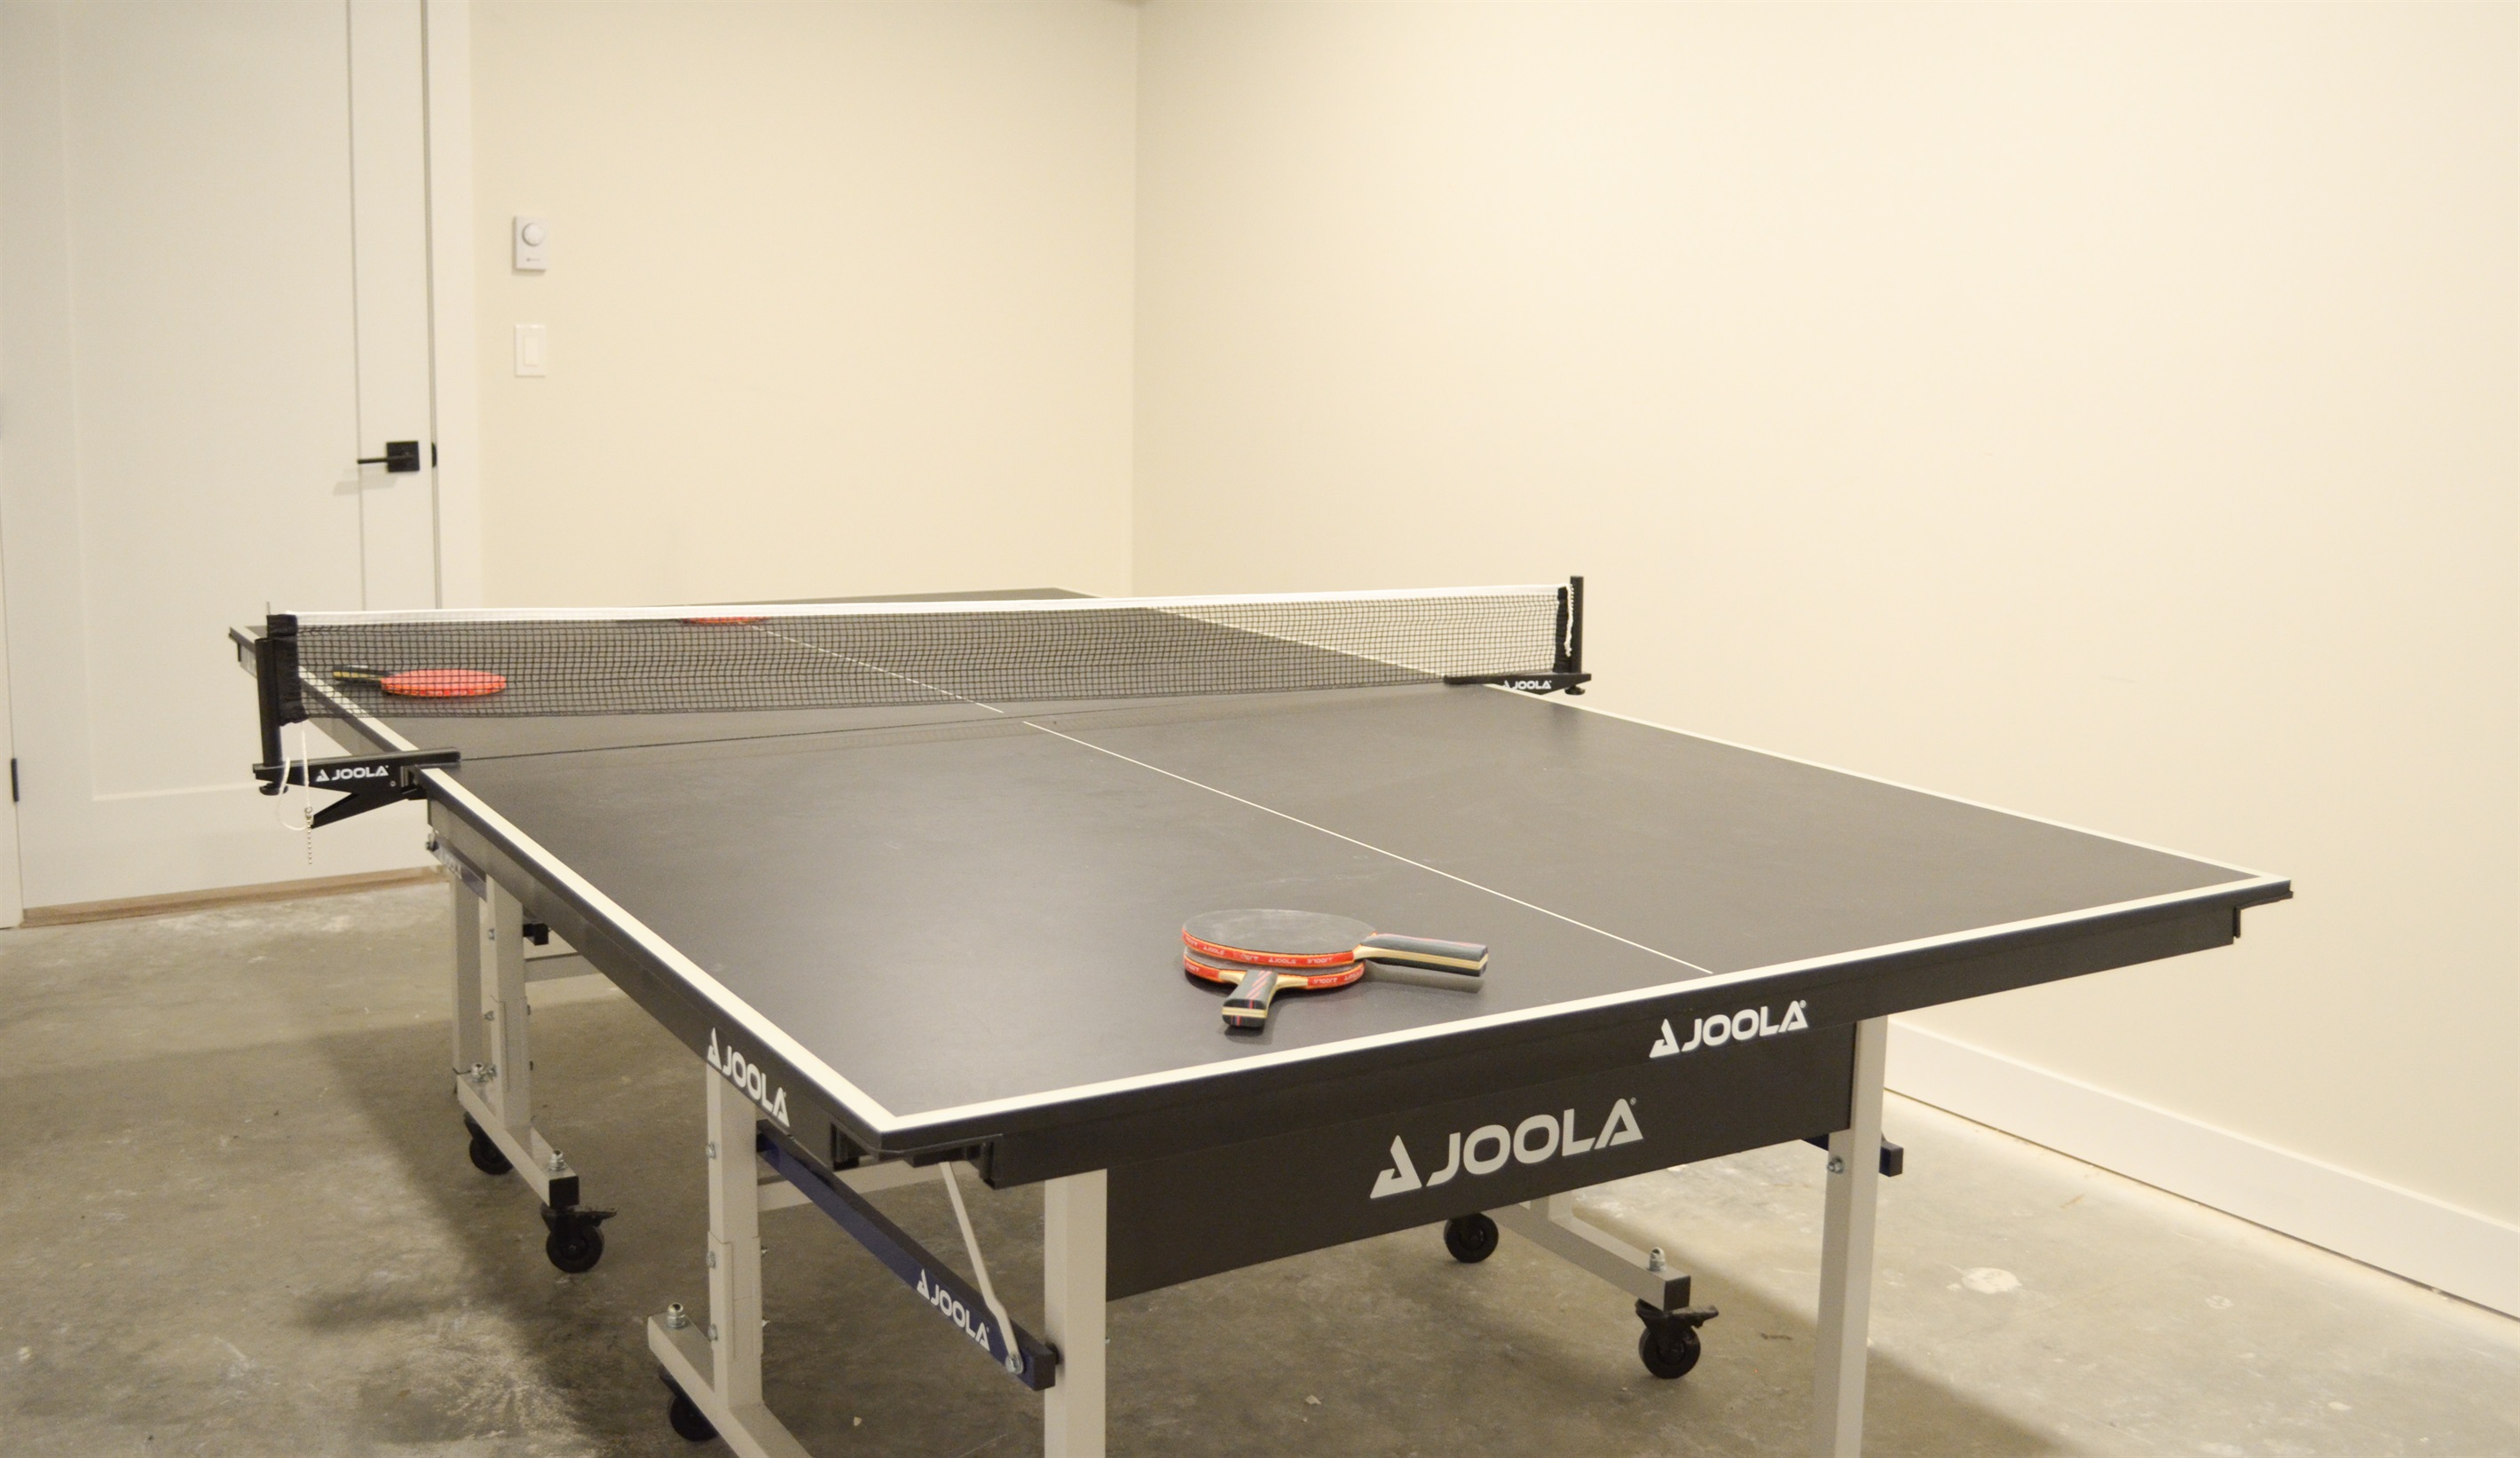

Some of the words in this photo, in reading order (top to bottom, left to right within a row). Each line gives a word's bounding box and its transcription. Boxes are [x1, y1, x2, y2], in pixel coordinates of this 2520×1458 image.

[1512, 680, 1551, 690] JOOLA
[331, 765, 389, 781] JOOLA
[1681, 999, 1808, 1052] JOOLA
[723, 1044, 790, 1128] JOOLA
[1425, 1098, 1643, 1187] JOOLA
[930, 1283, 990, 1352] JOOLA
